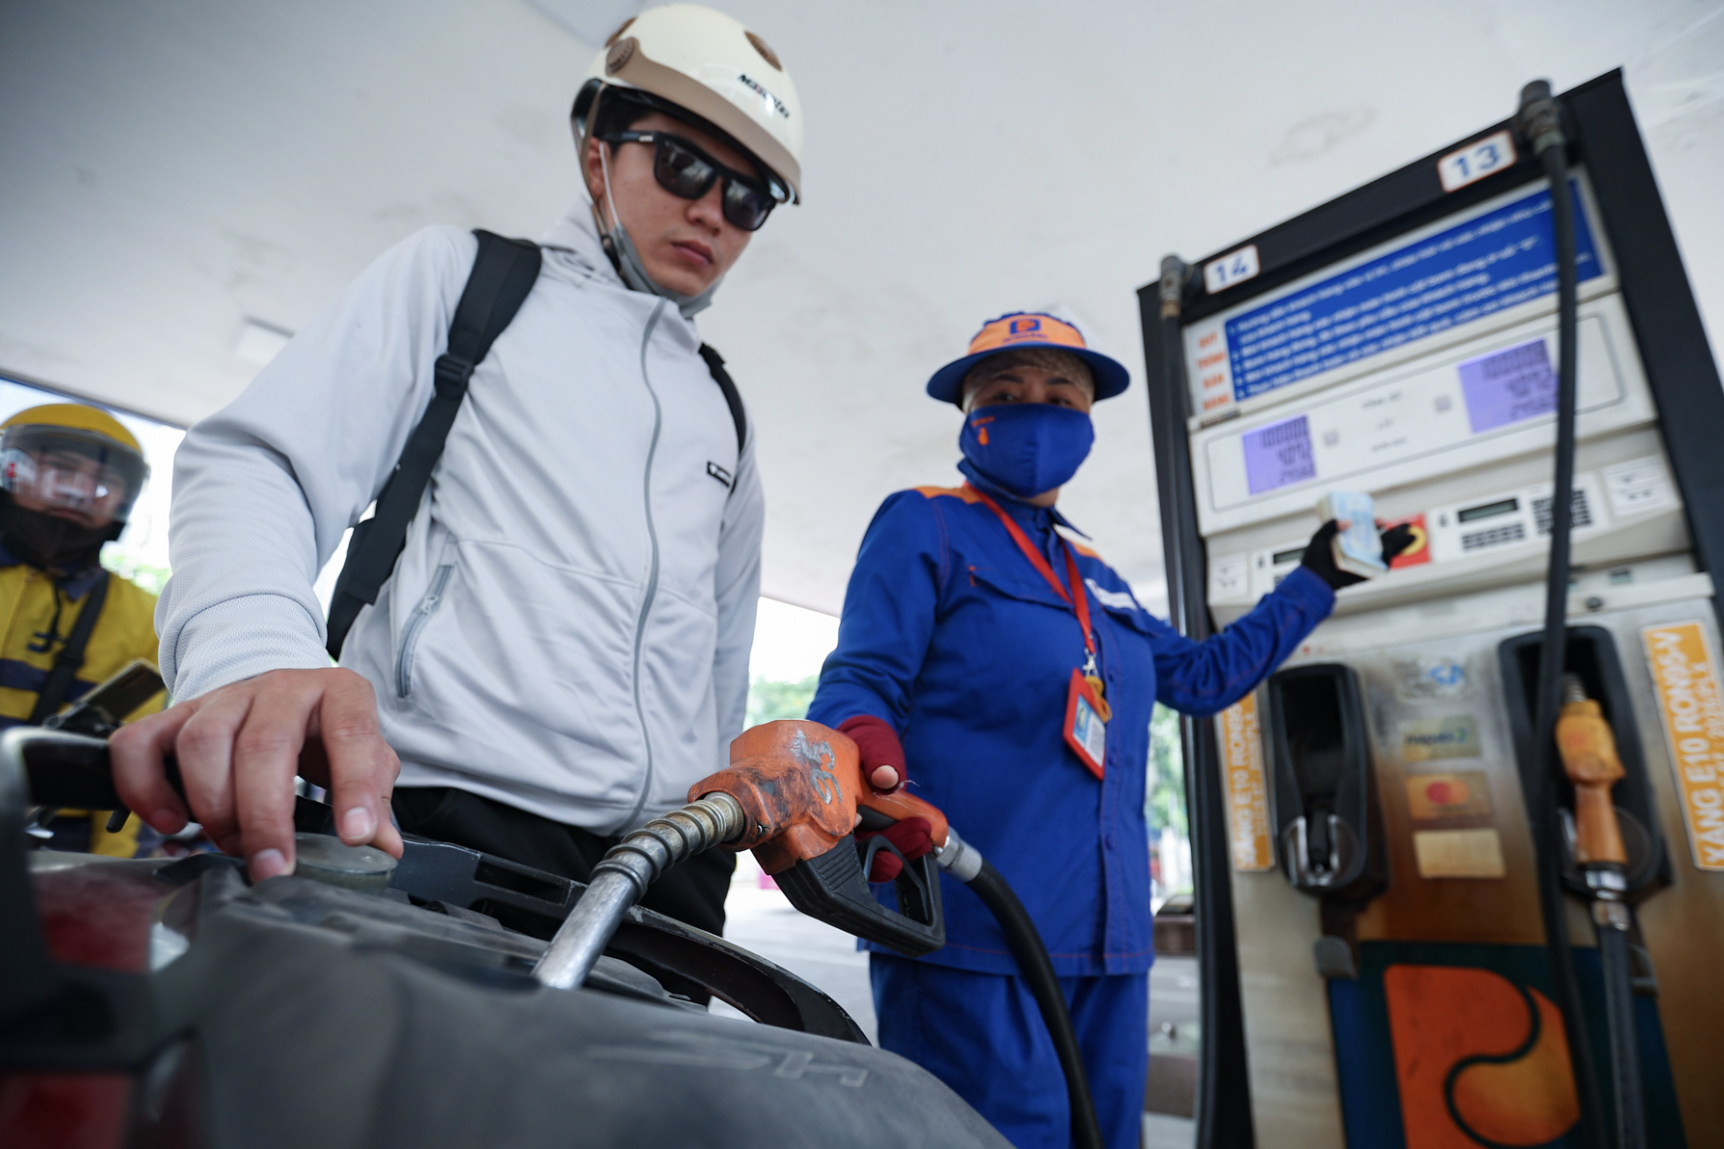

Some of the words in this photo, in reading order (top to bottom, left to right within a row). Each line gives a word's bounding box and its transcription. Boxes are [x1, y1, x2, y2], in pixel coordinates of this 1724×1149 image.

[1452, 143, 1500, 179] 13
[1216, 255, 1248, 284] 14
[1679, 737, 1717, 783] E10
